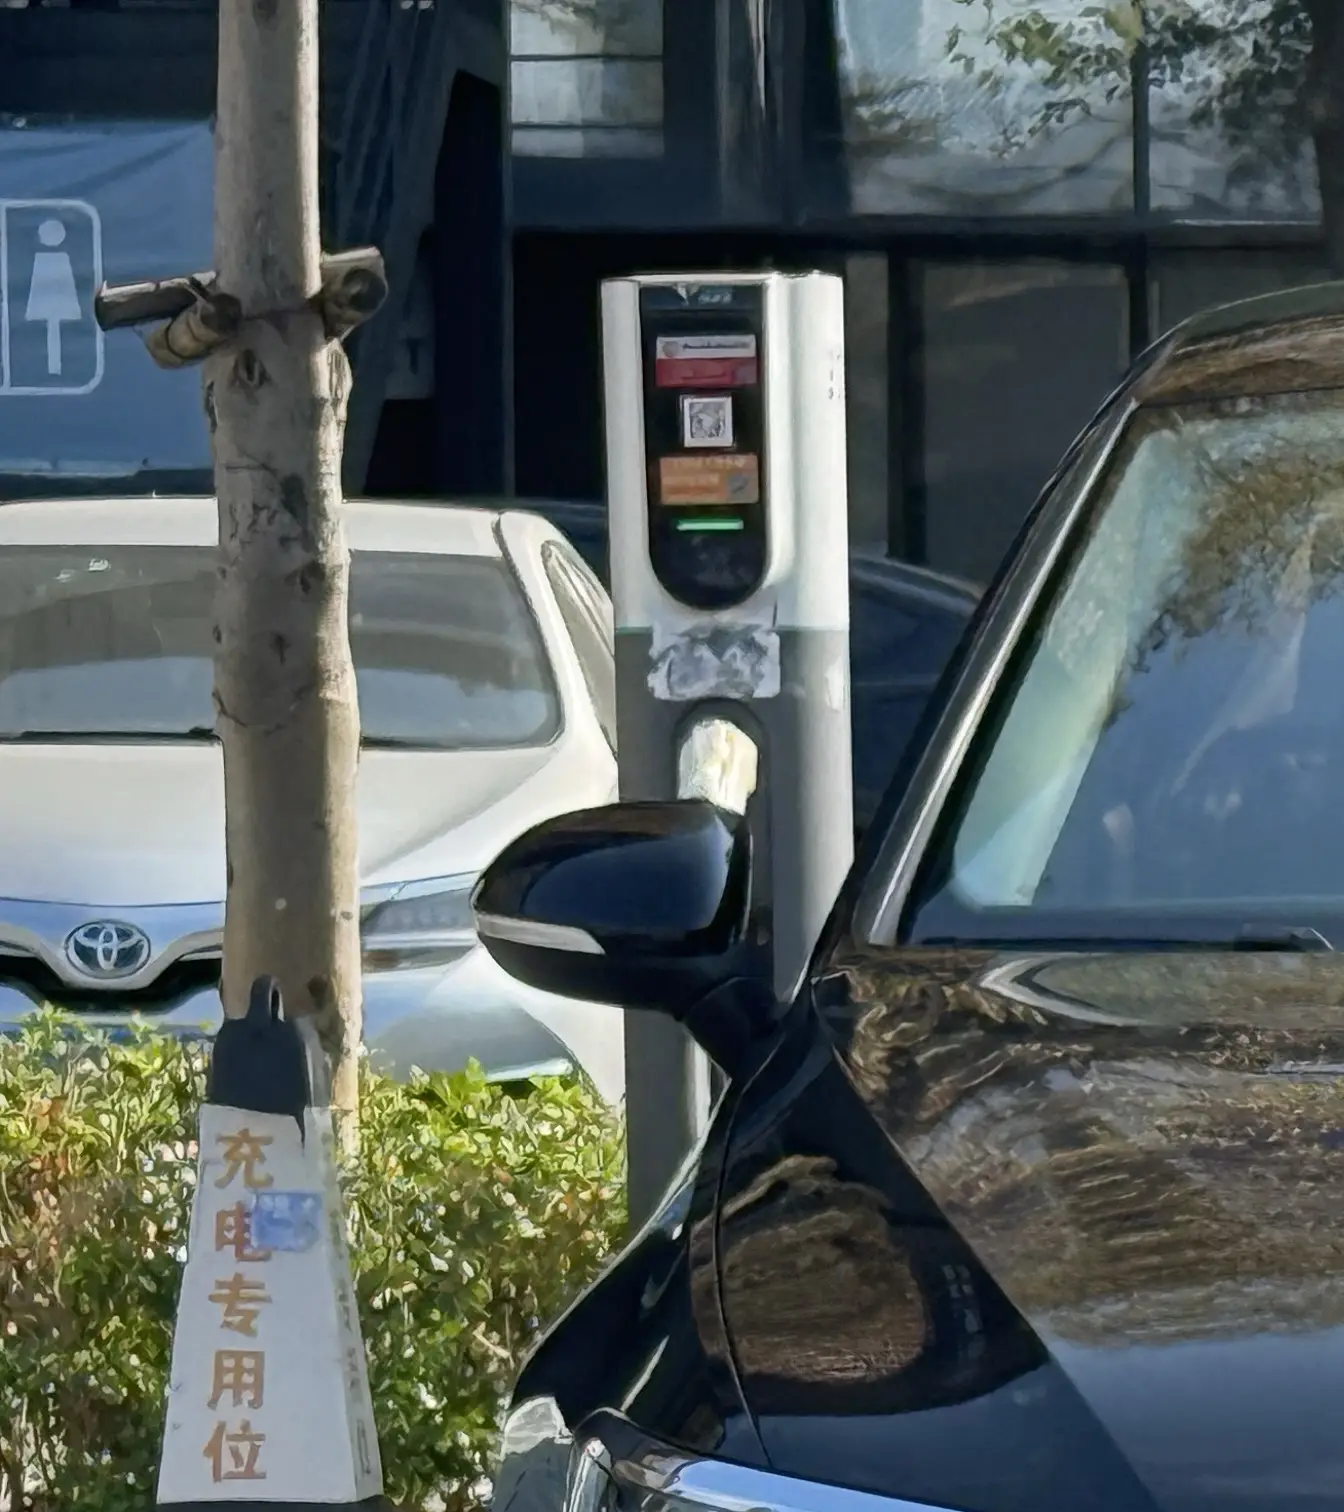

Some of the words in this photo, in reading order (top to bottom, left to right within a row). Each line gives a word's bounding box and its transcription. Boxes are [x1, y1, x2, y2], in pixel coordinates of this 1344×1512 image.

[203, 1128, 274, 1483] 充电专用位
